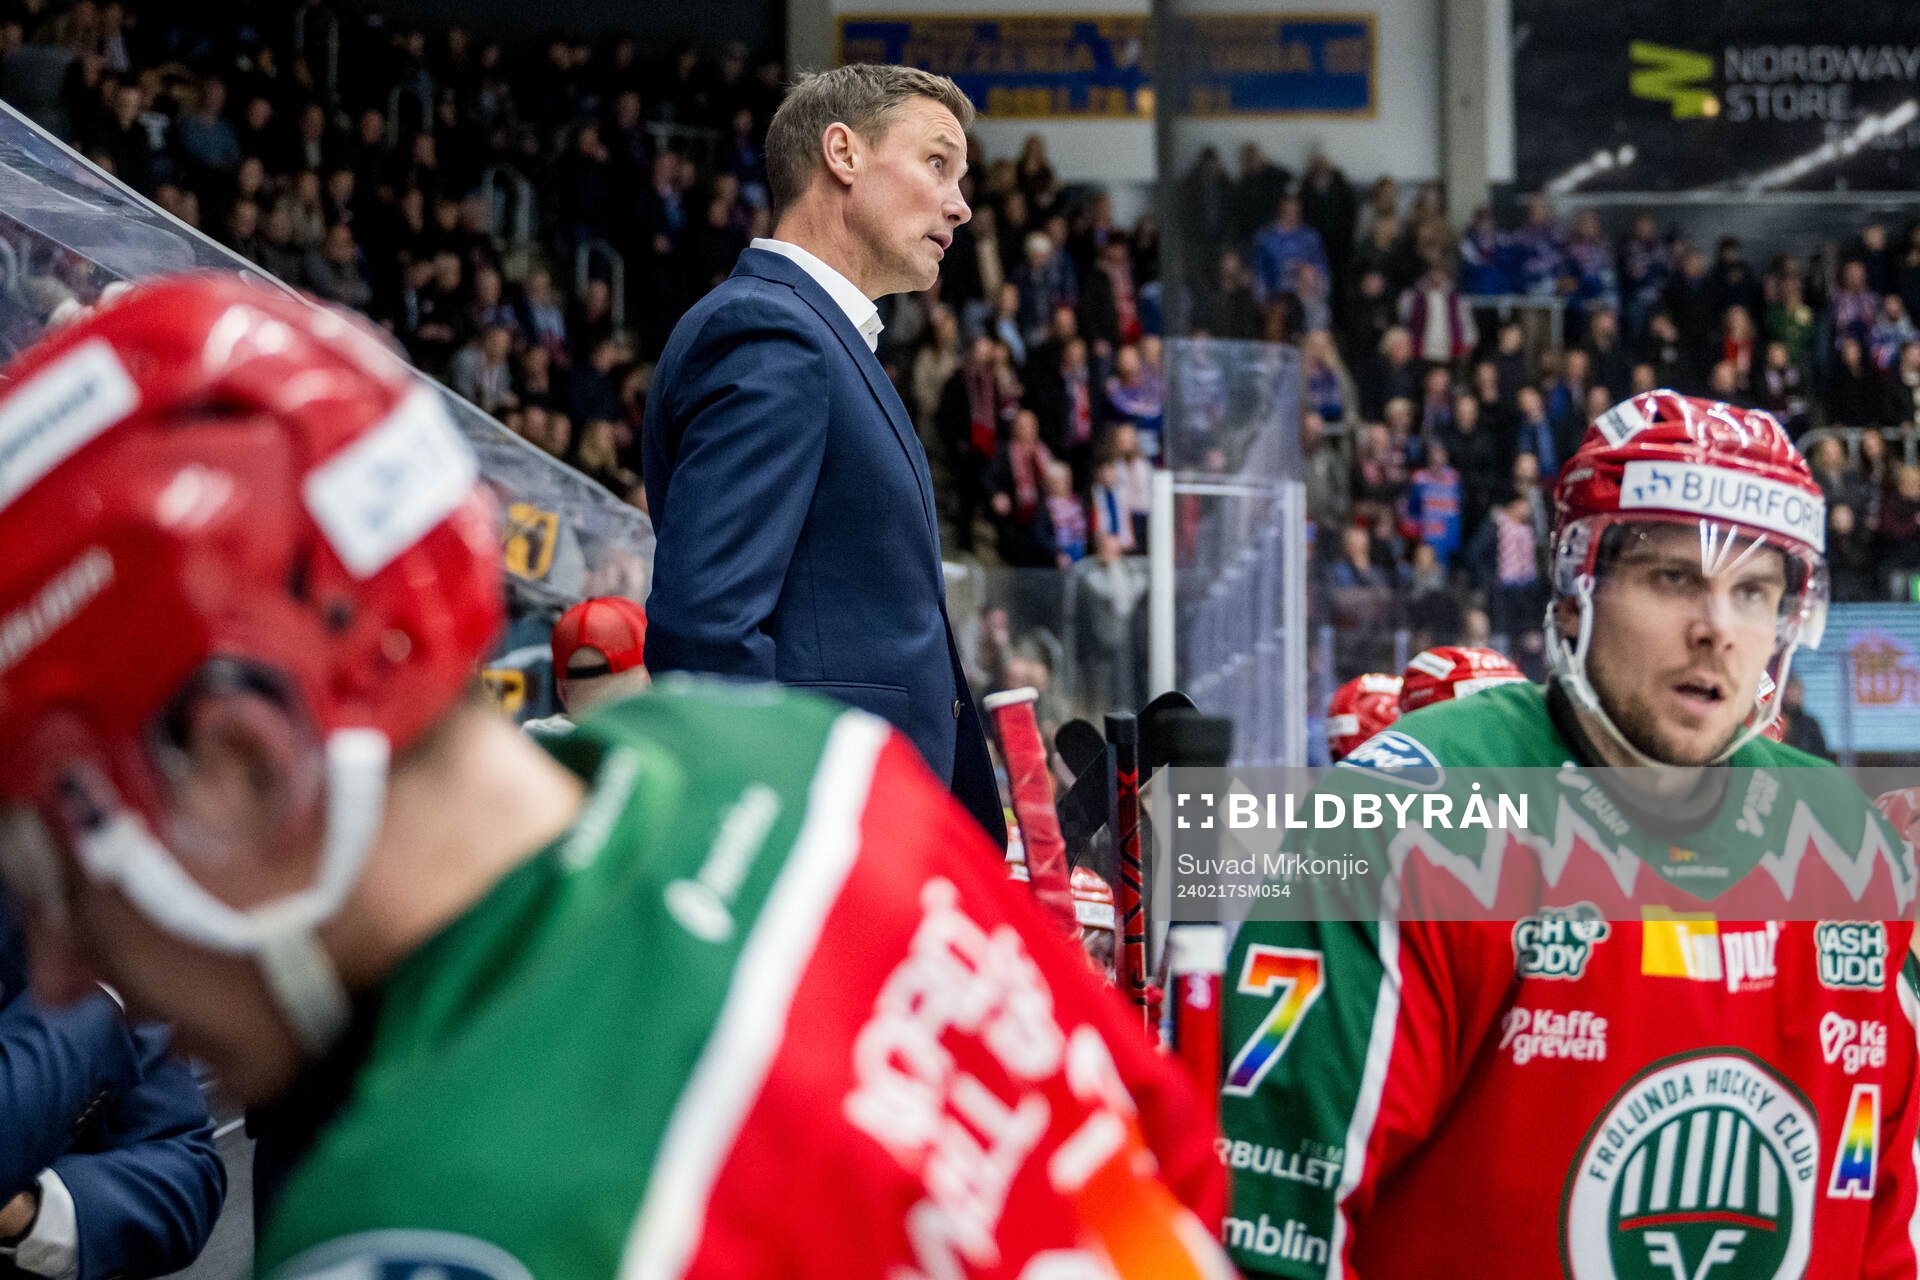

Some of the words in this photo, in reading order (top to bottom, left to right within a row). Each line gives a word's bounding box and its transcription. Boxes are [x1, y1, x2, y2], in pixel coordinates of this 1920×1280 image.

[1725, 45, 1920, 82] NORDWAY
[1725, 83, 1850, 121] STORE
[1222, 943, 1325, 1097] 7
[1532, 1008, 1608, 1038] Kaffe
[1513, 1033, 1608, 1065] greven
[1842, 1044, 1887, 1075] gre
[1706, 1069, 1776, 1112] HOCKEY
[1773, 1112, 1813, 1181] CLUB
[1826, 1083, 1880, 1199] A
[1213, 1137, 1341, 1189] RBULLET
[1222, 1213, 1328, 1265] mblin
